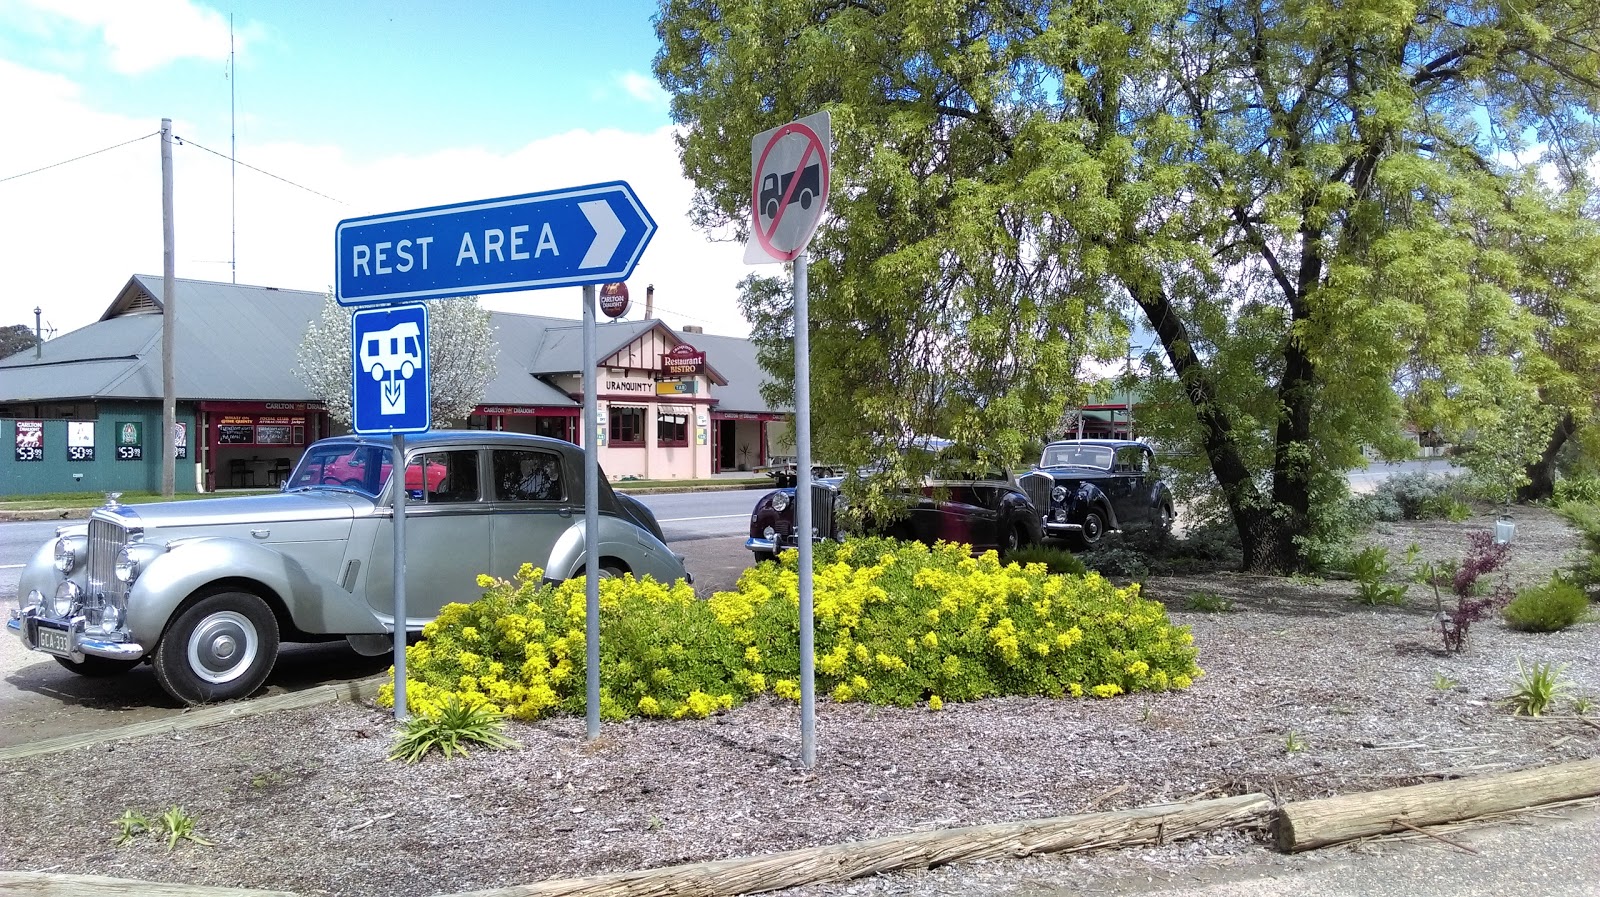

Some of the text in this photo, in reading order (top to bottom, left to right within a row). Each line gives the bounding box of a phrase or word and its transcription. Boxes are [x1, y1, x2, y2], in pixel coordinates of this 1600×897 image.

[353, 222, 560, 277] REST AREA
[664, 356, 702, 366] Restaurant
[670, 365, 696, 373] BISTRO
[606, 381, 652, 392] URANQUINTY
